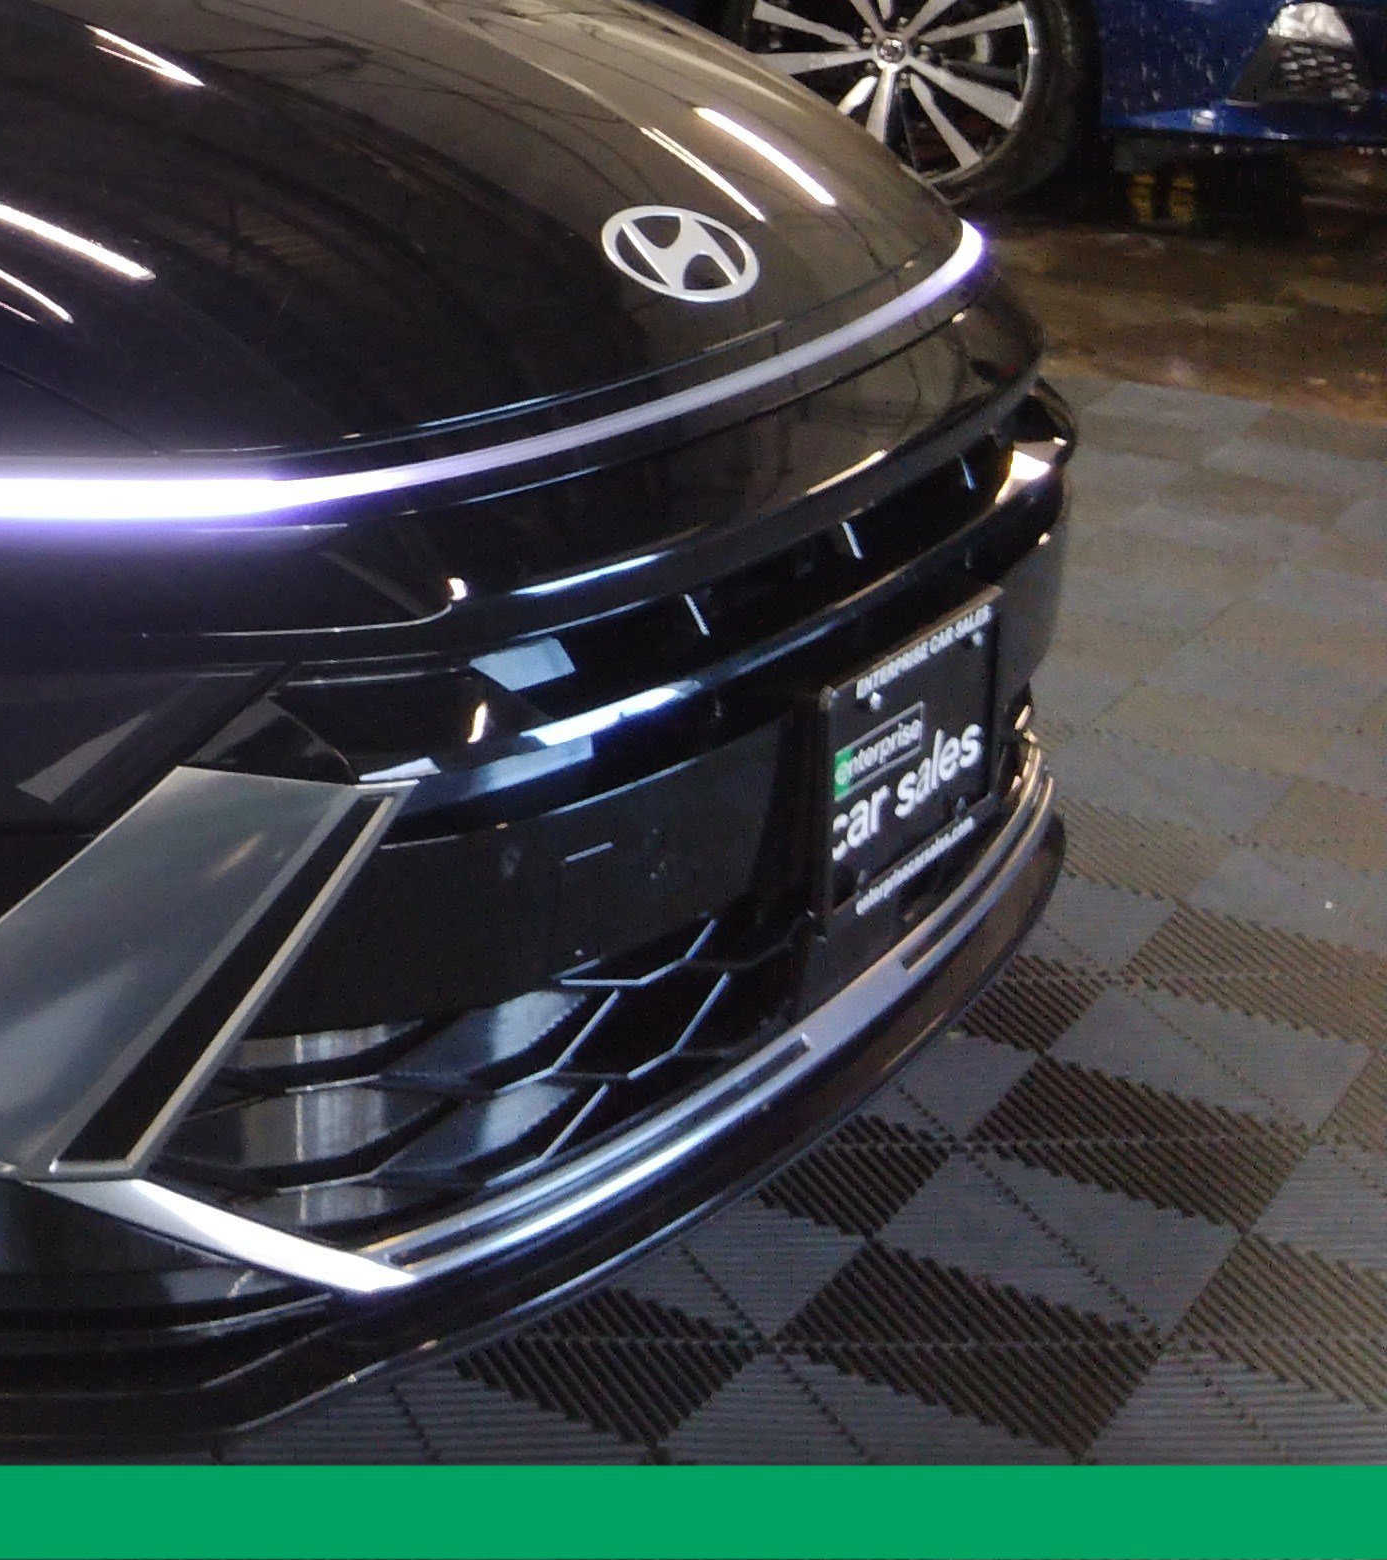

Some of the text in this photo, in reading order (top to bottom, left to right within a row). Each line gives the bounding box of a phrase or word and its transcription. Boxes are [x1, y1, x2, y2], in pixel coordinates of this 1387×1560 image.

[832, 723, 984, 861] car sales
[834, 719, 922, 785] enterprise
